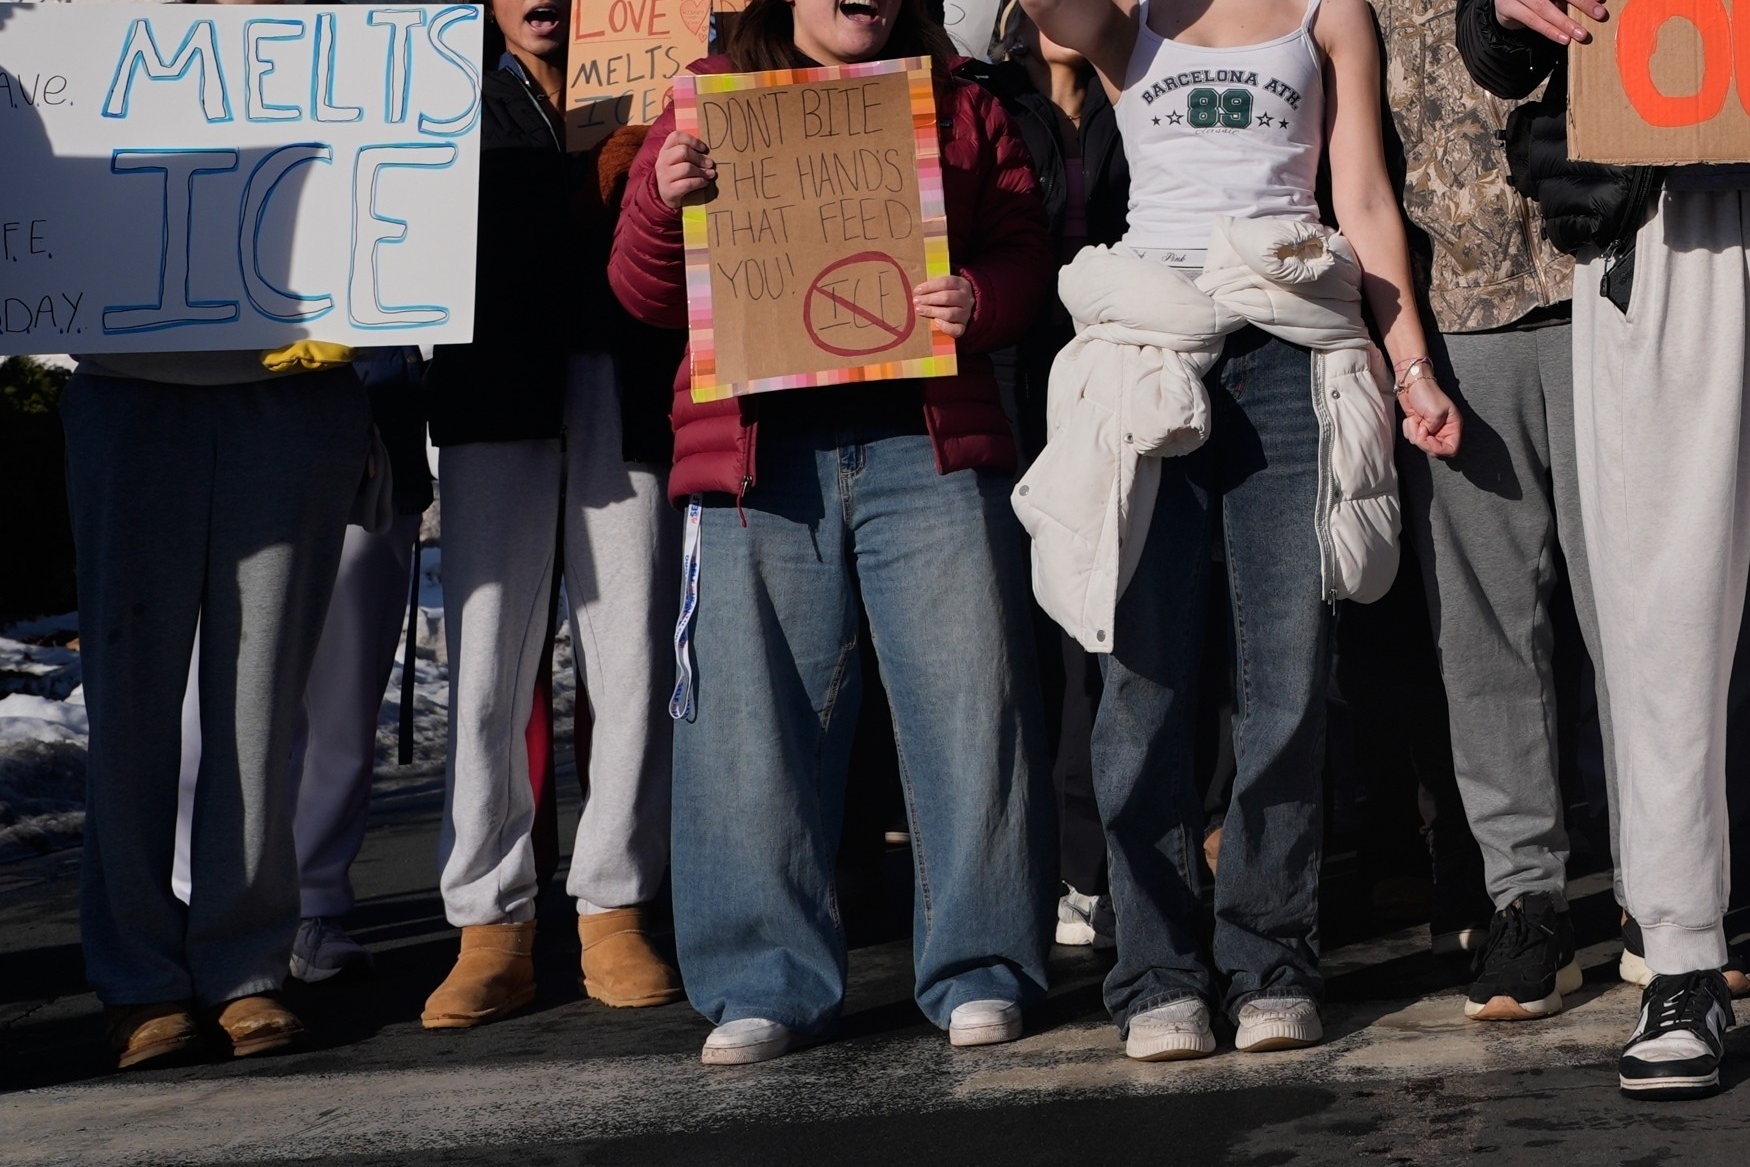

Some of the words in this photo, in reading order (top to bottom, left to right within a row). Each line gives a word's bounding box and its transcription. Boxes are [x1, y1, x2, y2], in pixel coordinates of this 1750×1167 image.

[101, 5, 482, 136] MELTS
[570, 45, 680, 88] MELTS
[1141, 69, 1259, 105] BARCELONA
[1264, 77, 1301, 111] ATH.
[574, 89, 659, 128] ICE
[703, 91, 788, 152] DON'T
[802, 83, 883, 139] BITE
[1187, 87, 1254, 130] 89
[102, 141, 458, 334] ICE
[708, 204, 795, 247] THAT
[819, 198, 912, 243] FEED
[717, 252, 795, 301] YOU!
[1161, 252, 1186, 262] Pink
[819, 270, 902, 330] ICE
